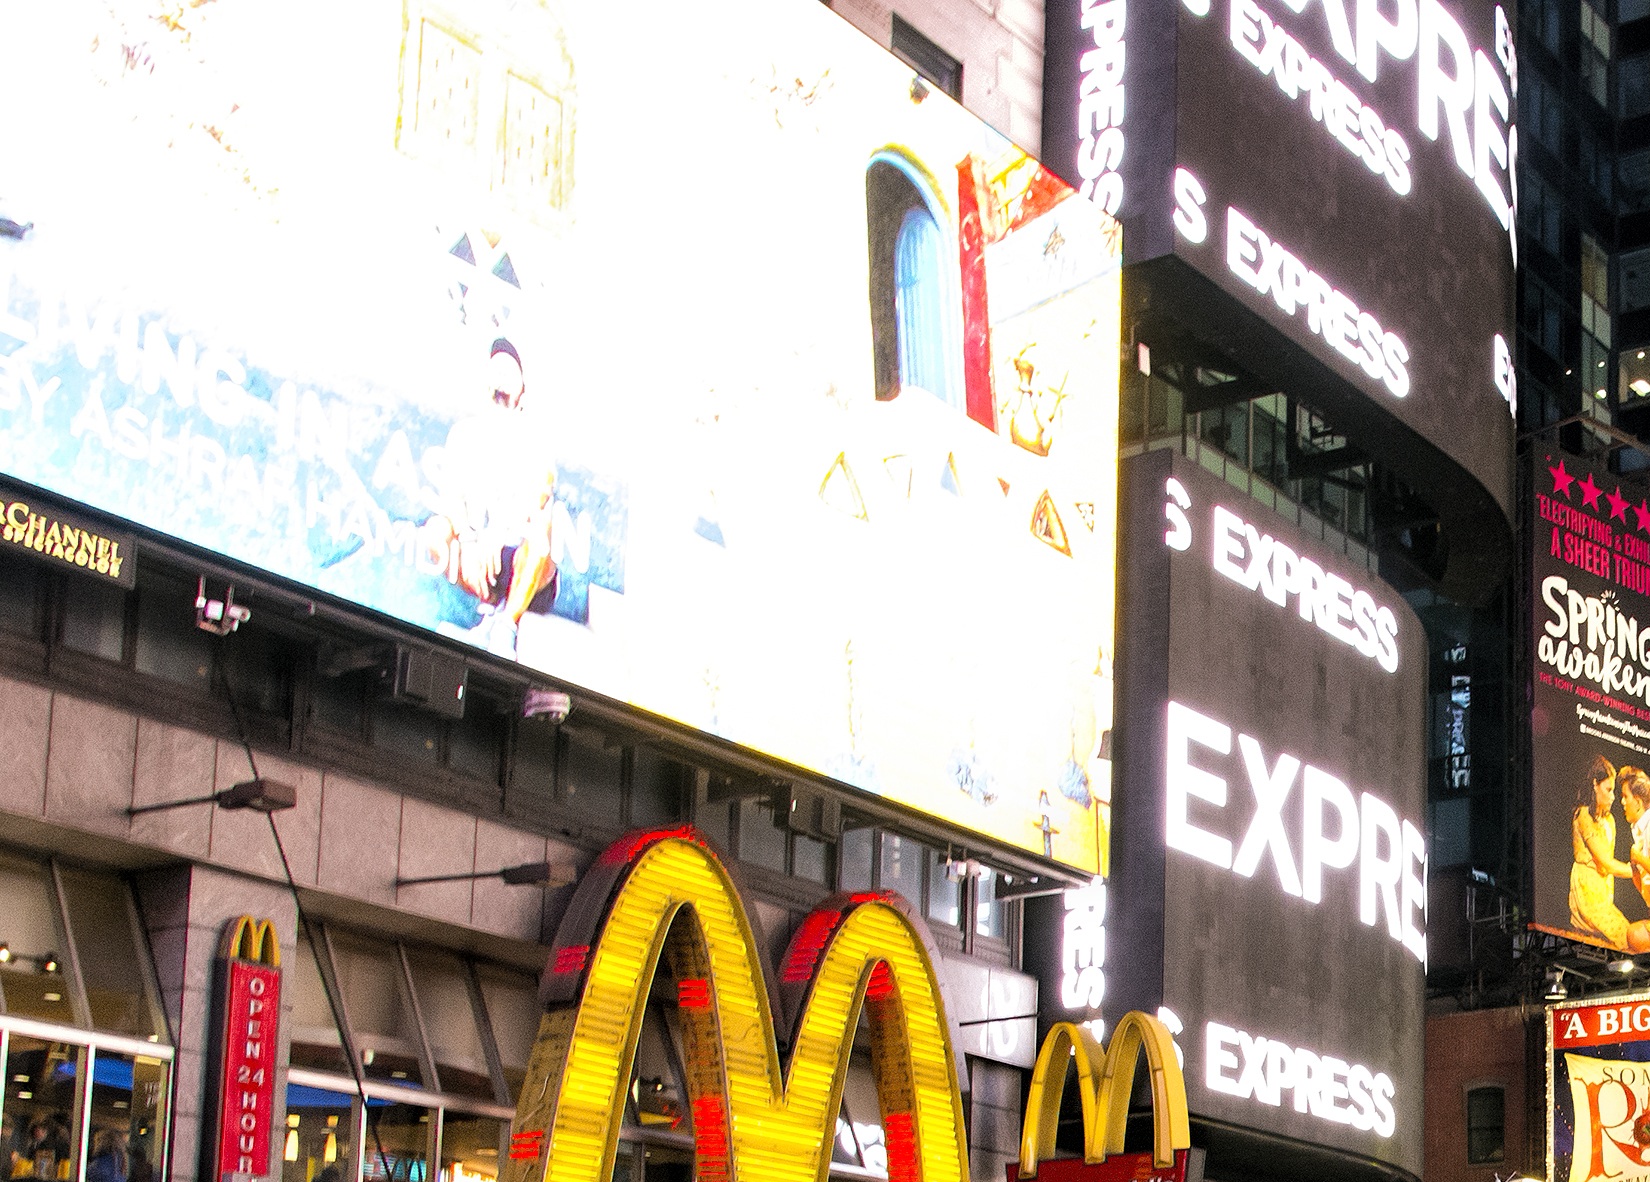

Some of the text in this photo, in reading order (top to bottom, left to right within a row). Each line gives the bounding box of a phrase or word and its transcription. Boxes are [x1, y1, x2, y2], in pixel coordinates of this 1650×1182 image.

[1230, 0, 1411, 195] EXPRESS
[1228, 206, 1410, 397] EXPRESS
[7, 501, 123, 563] CHANNEL
[1213, 505, 1399, 673] EXPRESS
[1551, 526, 1561, 559] A
[1564, 532, 1610, 580] SHEER
[1165, 699, 1428, 977] EXPRE
[246, 976, 265, 1060] OPEN
[237, 1066, 266, 1088] 24
[1206, 1021, 1397, 1138] EXPRESS
